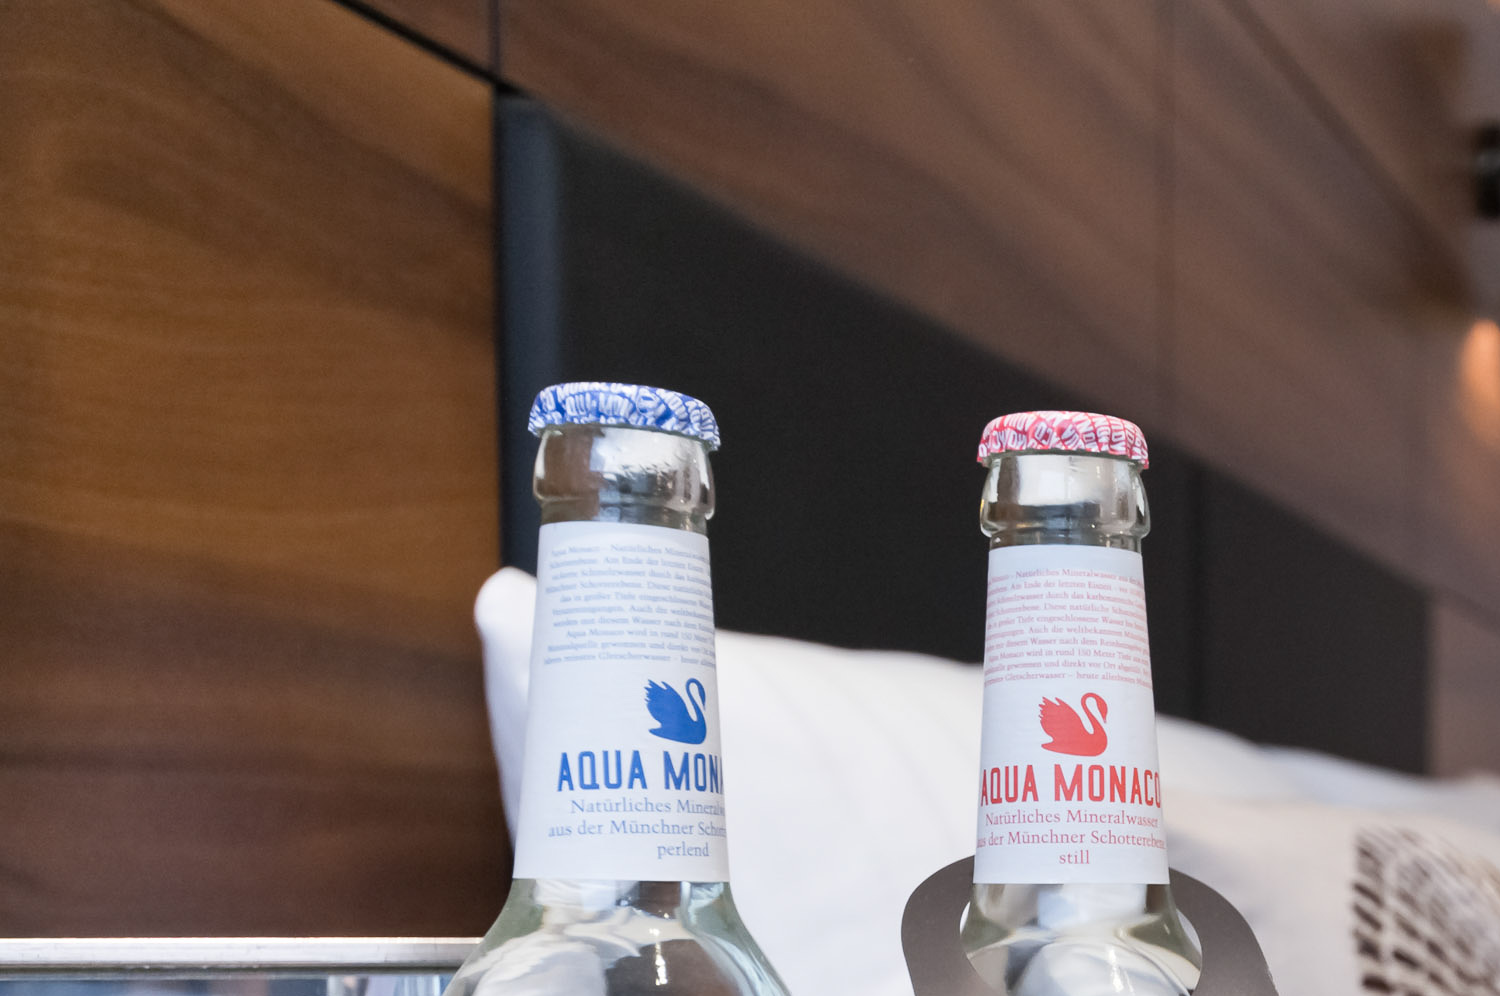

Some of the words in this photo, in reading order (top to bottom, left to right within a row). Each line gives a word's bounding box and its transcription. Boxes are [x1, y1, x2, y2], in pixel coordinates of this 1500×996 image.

[557, 750, 648, 792] AQUA
[980, 764, 1039, 807] AQUA
[1054, 763, 1161, 809] MONACO
[569, 797, 672, 815] Natürliches
[577, 819, 604, 836] der
[609, 819, 694, 836] Münchner
[985, 808, 1061, 826] Natürliches
[1066, 809, 1159, 828] Mineralwasser
[988, 832, 1004, 846] der
[1007, 829, 1086, 846] Münchner
[657, 840, 710, 860] perlend
[1058, 850, 1091, 865] still
